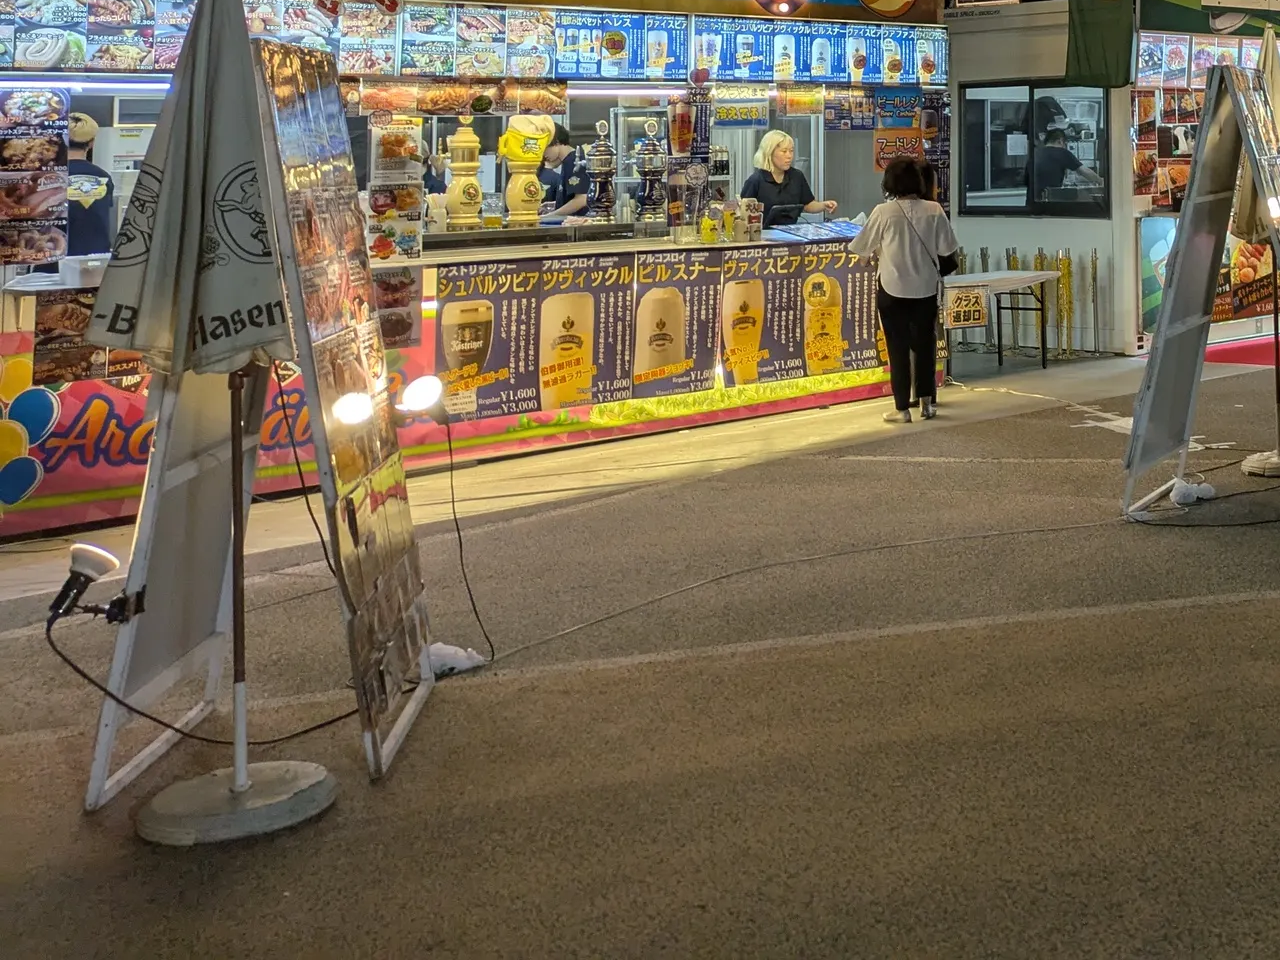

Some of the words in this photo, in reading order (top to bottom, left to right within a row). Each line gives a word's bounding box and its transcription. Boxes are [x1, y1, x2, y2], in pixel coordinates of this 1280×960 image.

[603, 18, 632, 27] ヘレス
[716, 86, 766, 99] グラスまで
[877, 96, 919, 107] ビールレジ
[880, 110, 895, 118] Beer
[877, 137, 920, 150] フードレジ
[724, 248, 769, 260] アルコブロイ
[804, 242, 846, 254] アルコブロイ
[542, 257, 595, 270] アルコブロイ
[638, 252, 686, 264] アルコブロイ
[804, 252, 860, 271] ウアファ
[438, 263, 517, 278] ケストリッツァー
[639, 262, 721, 284] ピルスナー
[724, 256, 801, 278] ヴァイスビア
[542, 266, 634, 291] ツヴィックル
[438, 272, 540, 299] シュバルツビア
[954, 295, 981, 309] グラス
[952, 308, 982, 324] 返却口
[851, 348, 877, 360] ¥1,600
[774, 358, 803, 370] ¥1,600
[852, 359, 878, 370] ¥3,000
[775, 369, 804, 381] ¥3,000
[598, 378, 630, 392] ¥1,600
[478, 396, 501, 406] Regular
[501, 387, 536, 402] ¥1,600
[598, 391, 631, 403] ¥3,000
[501, 399, 538, 413] ¥3,000
